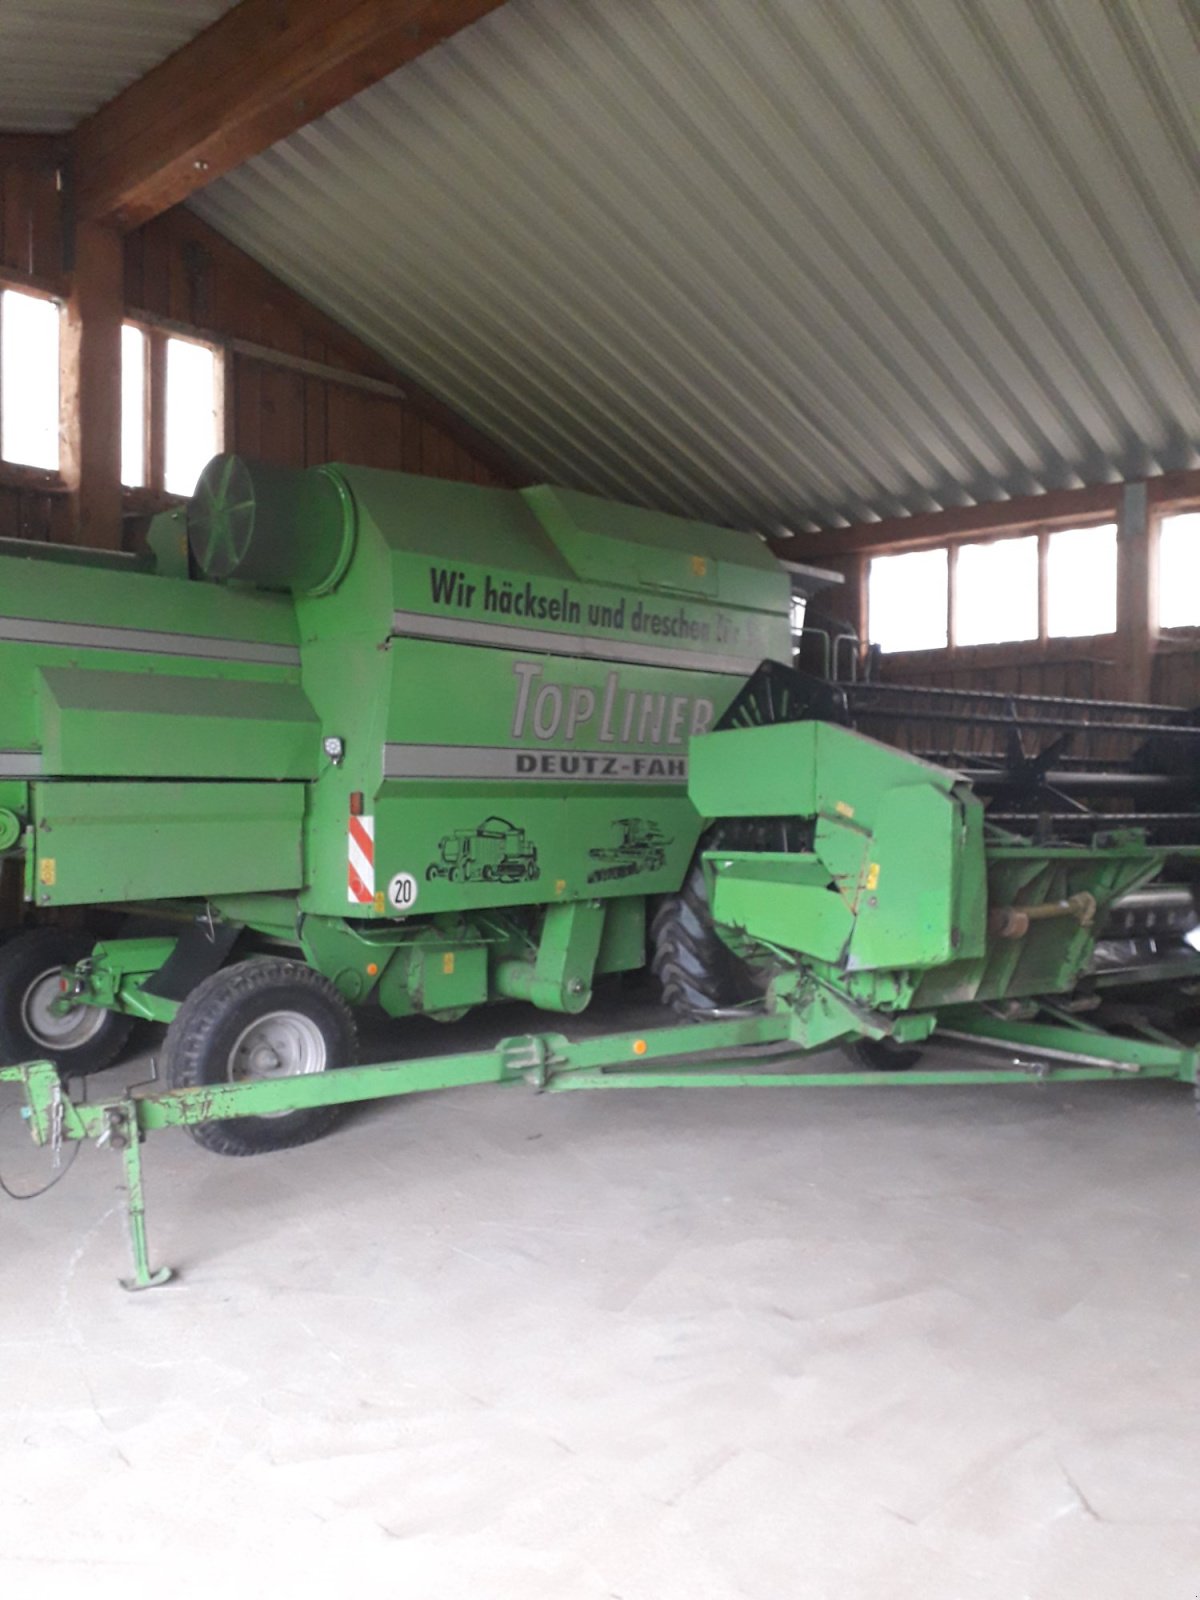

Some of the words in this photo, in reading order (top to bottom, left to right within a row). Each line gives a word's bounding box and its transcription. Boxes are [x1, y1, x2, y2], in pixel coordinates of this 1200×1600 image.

[430, 567, 476, 608] Wir
[483, 575, 581, 624] häckseln
[587, 598, 626, 630] und
[631, 601, 711, 642] dreschen
[516, 754, 685, 776] DEUTZ-FAH
[394, 879, 412, 904] 20
